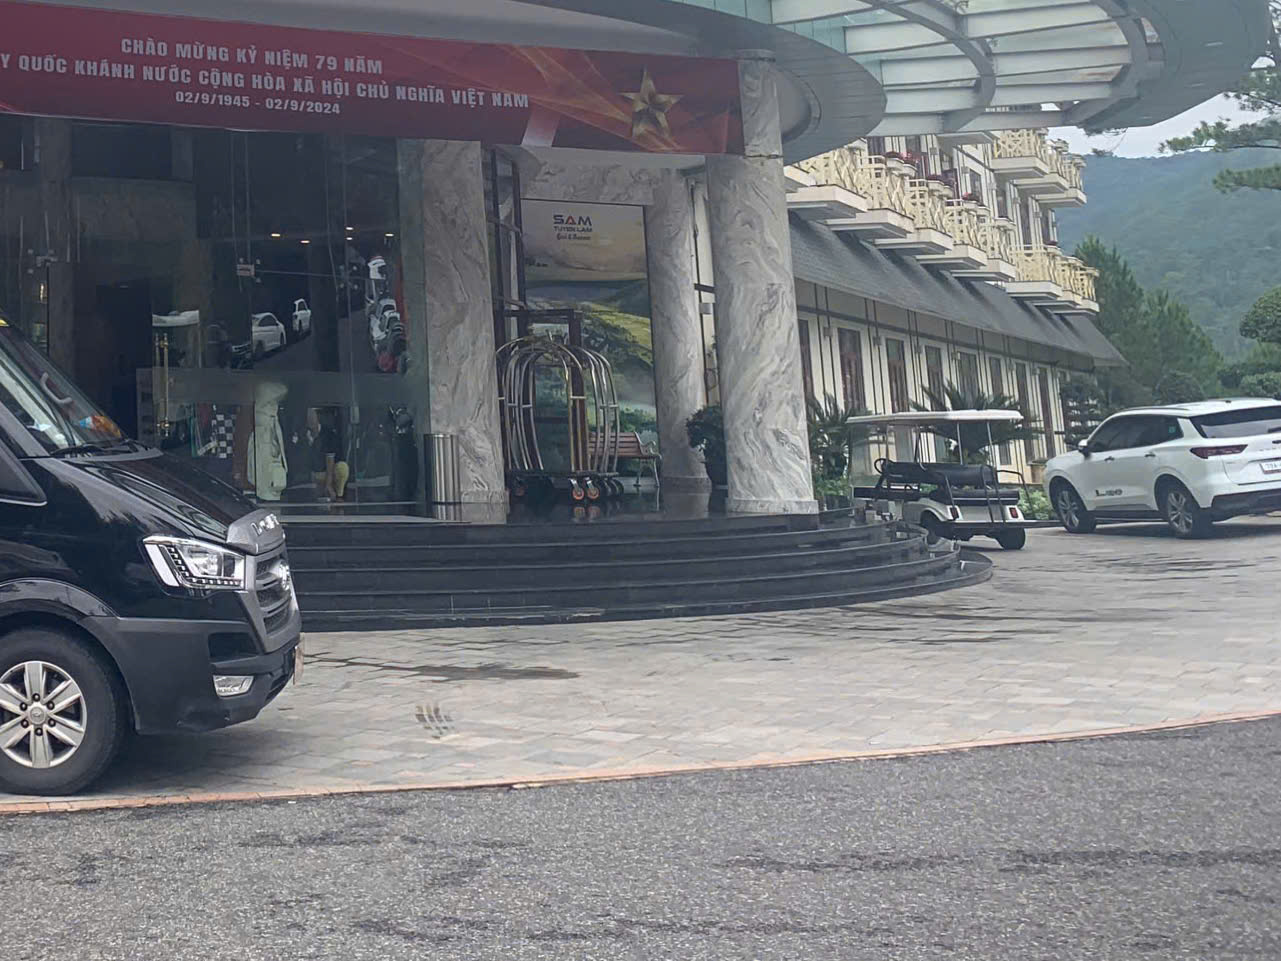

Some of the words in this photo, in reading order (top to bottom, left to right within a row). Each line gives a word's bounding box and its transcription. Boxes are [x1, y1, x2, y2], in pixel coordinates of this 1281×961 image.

[121, 38, 168, 57] CHÀO
[176, 42, 229, 61] MỪNG
[237, 45, 257, 64] KỶ
[265, 49, 308, 70] NIỆM
[315, 55, 337, 71] 79
[344, 56, 382, 74] NĂM
[19, 54, 67, 73] QUỐC
[75, 59, 135, 79] KHÁNH
[143, 64, 191, 83] NƯỚC
[199, 68, 245, 89] CỘNG
[252, 73, 286, 91] HÒA
[293, 76, 315, 93] XÃ
[322, 78, 349, 99] HỘI
[356, 80, 389, 99] CHỦ
[396, 85, 445, 104] NGHĨA
[452, 88, 485, 108] VIỆT
[492, 92, 529, 108] NAM
[176, 91, 250, 107] 02/9/1945
[265, 98, 341, 114] 02/9/2024
[553, 214, 592, 226] SAM
